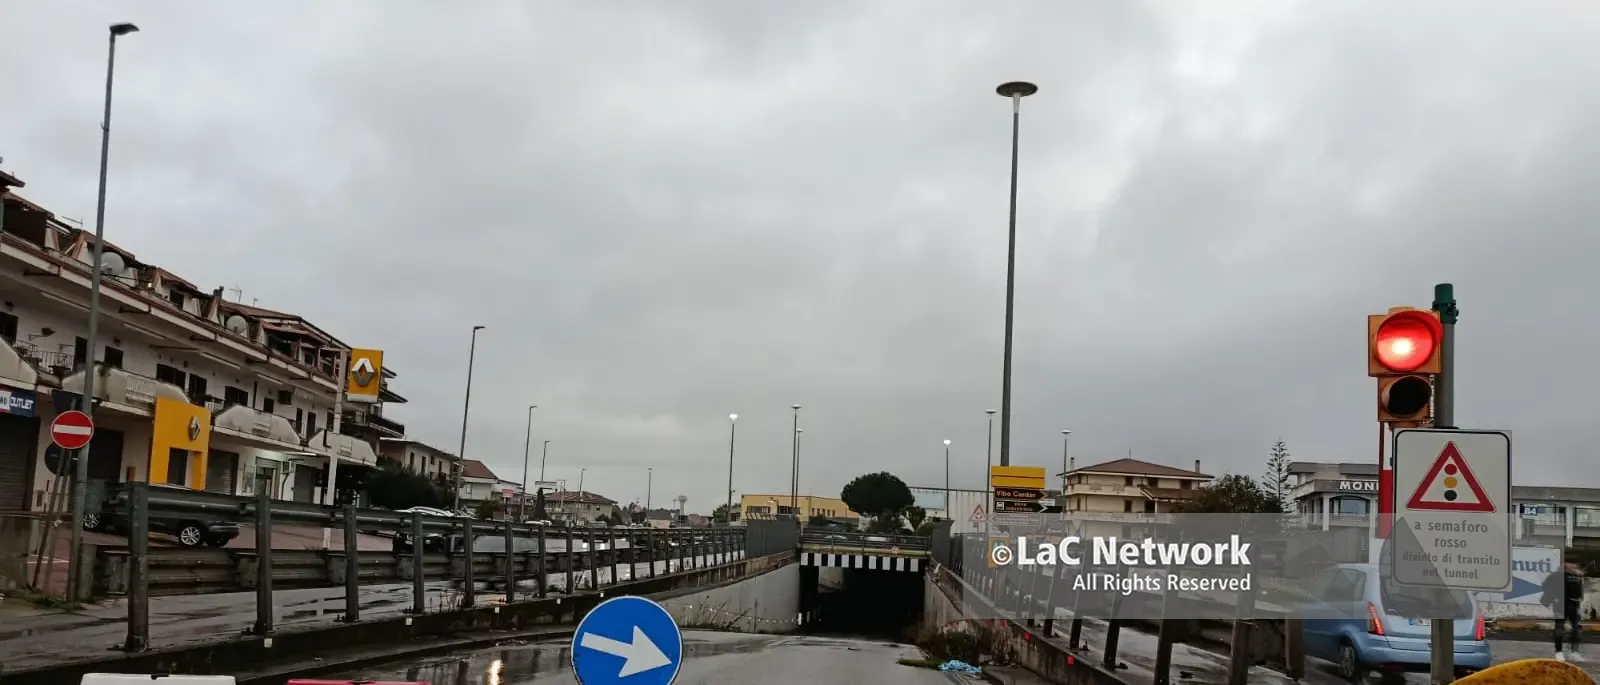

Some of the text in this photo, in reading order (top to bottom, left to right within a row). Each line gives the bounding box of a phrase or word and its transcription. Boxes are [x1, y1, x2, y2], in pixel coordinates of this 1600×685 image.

[10, 396, 34, 410] OUTLET
[1340, 481, 1379, 491] MON
[1414, 520, 1489, 533] a semaforo
[1434, 538, 1467, 548] rosso
[1403, 551, 1501, 565] divieto di transito
[1423, 567, 1479, 579] nel tunnel
